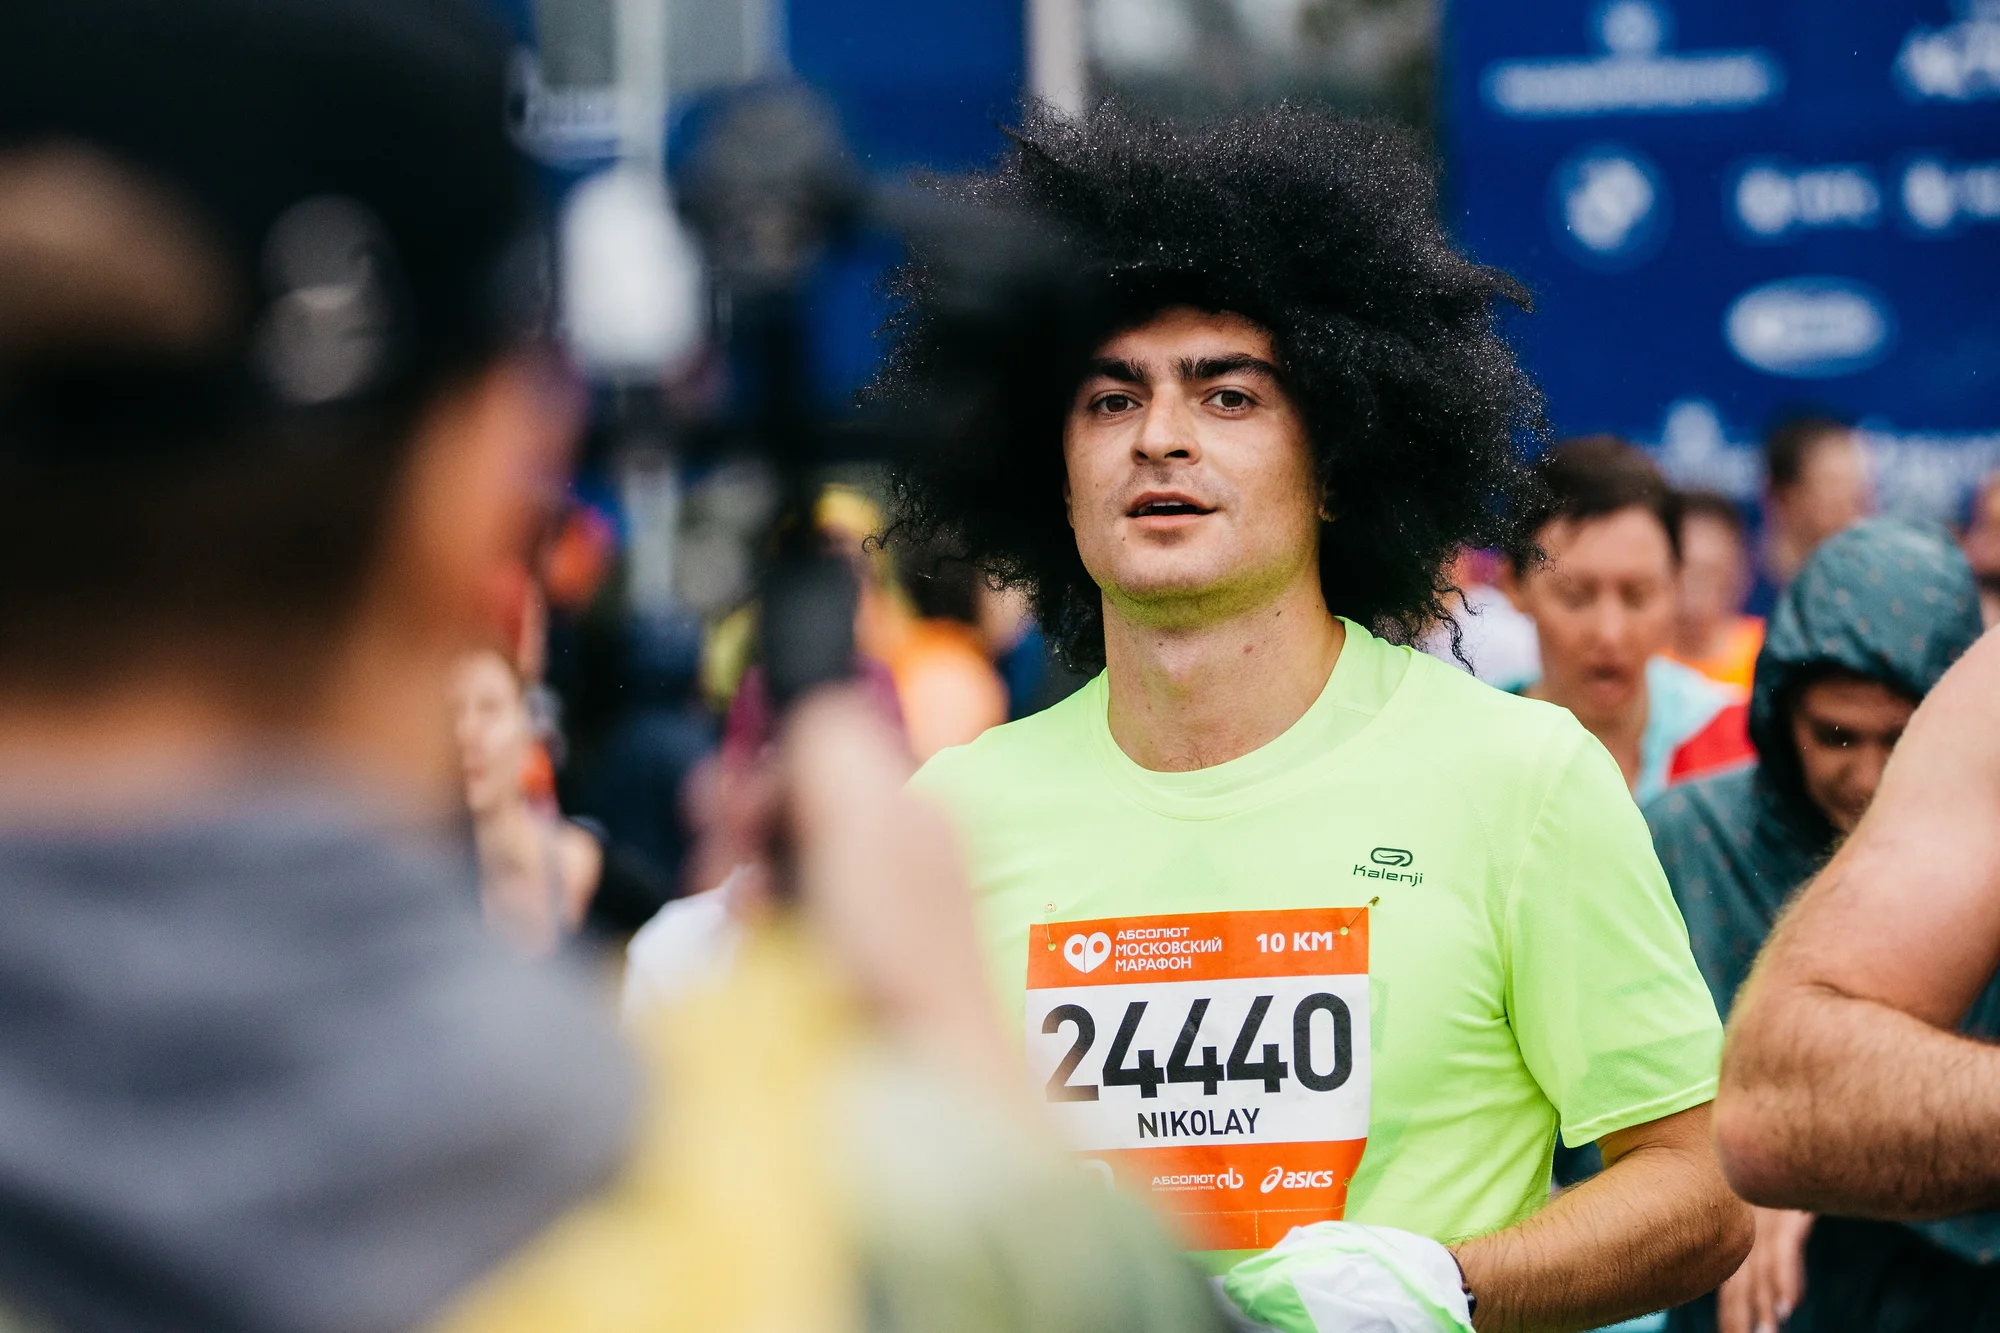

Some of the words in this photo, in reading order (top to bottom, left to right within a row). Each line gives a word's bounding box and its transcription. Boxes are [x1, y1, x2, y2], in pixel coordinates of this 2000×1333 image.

[1353, 864, 1423, 887] Kalenji
[1116, 927, 1190, 940] АБСОЛЮТ
[1256, 932, 1286, 953] 10
[1115, 936, 1222, 957] МОСКОВСКИЙ
[1115, 956, 1192, 972] МАРАФОН
[1041, 992, 1353, 1103] 24440
[1138, 1107, 1261, 1139] NIKOLAY
[1152, 1174, 1215, 1186] АБСОЛЮТ
